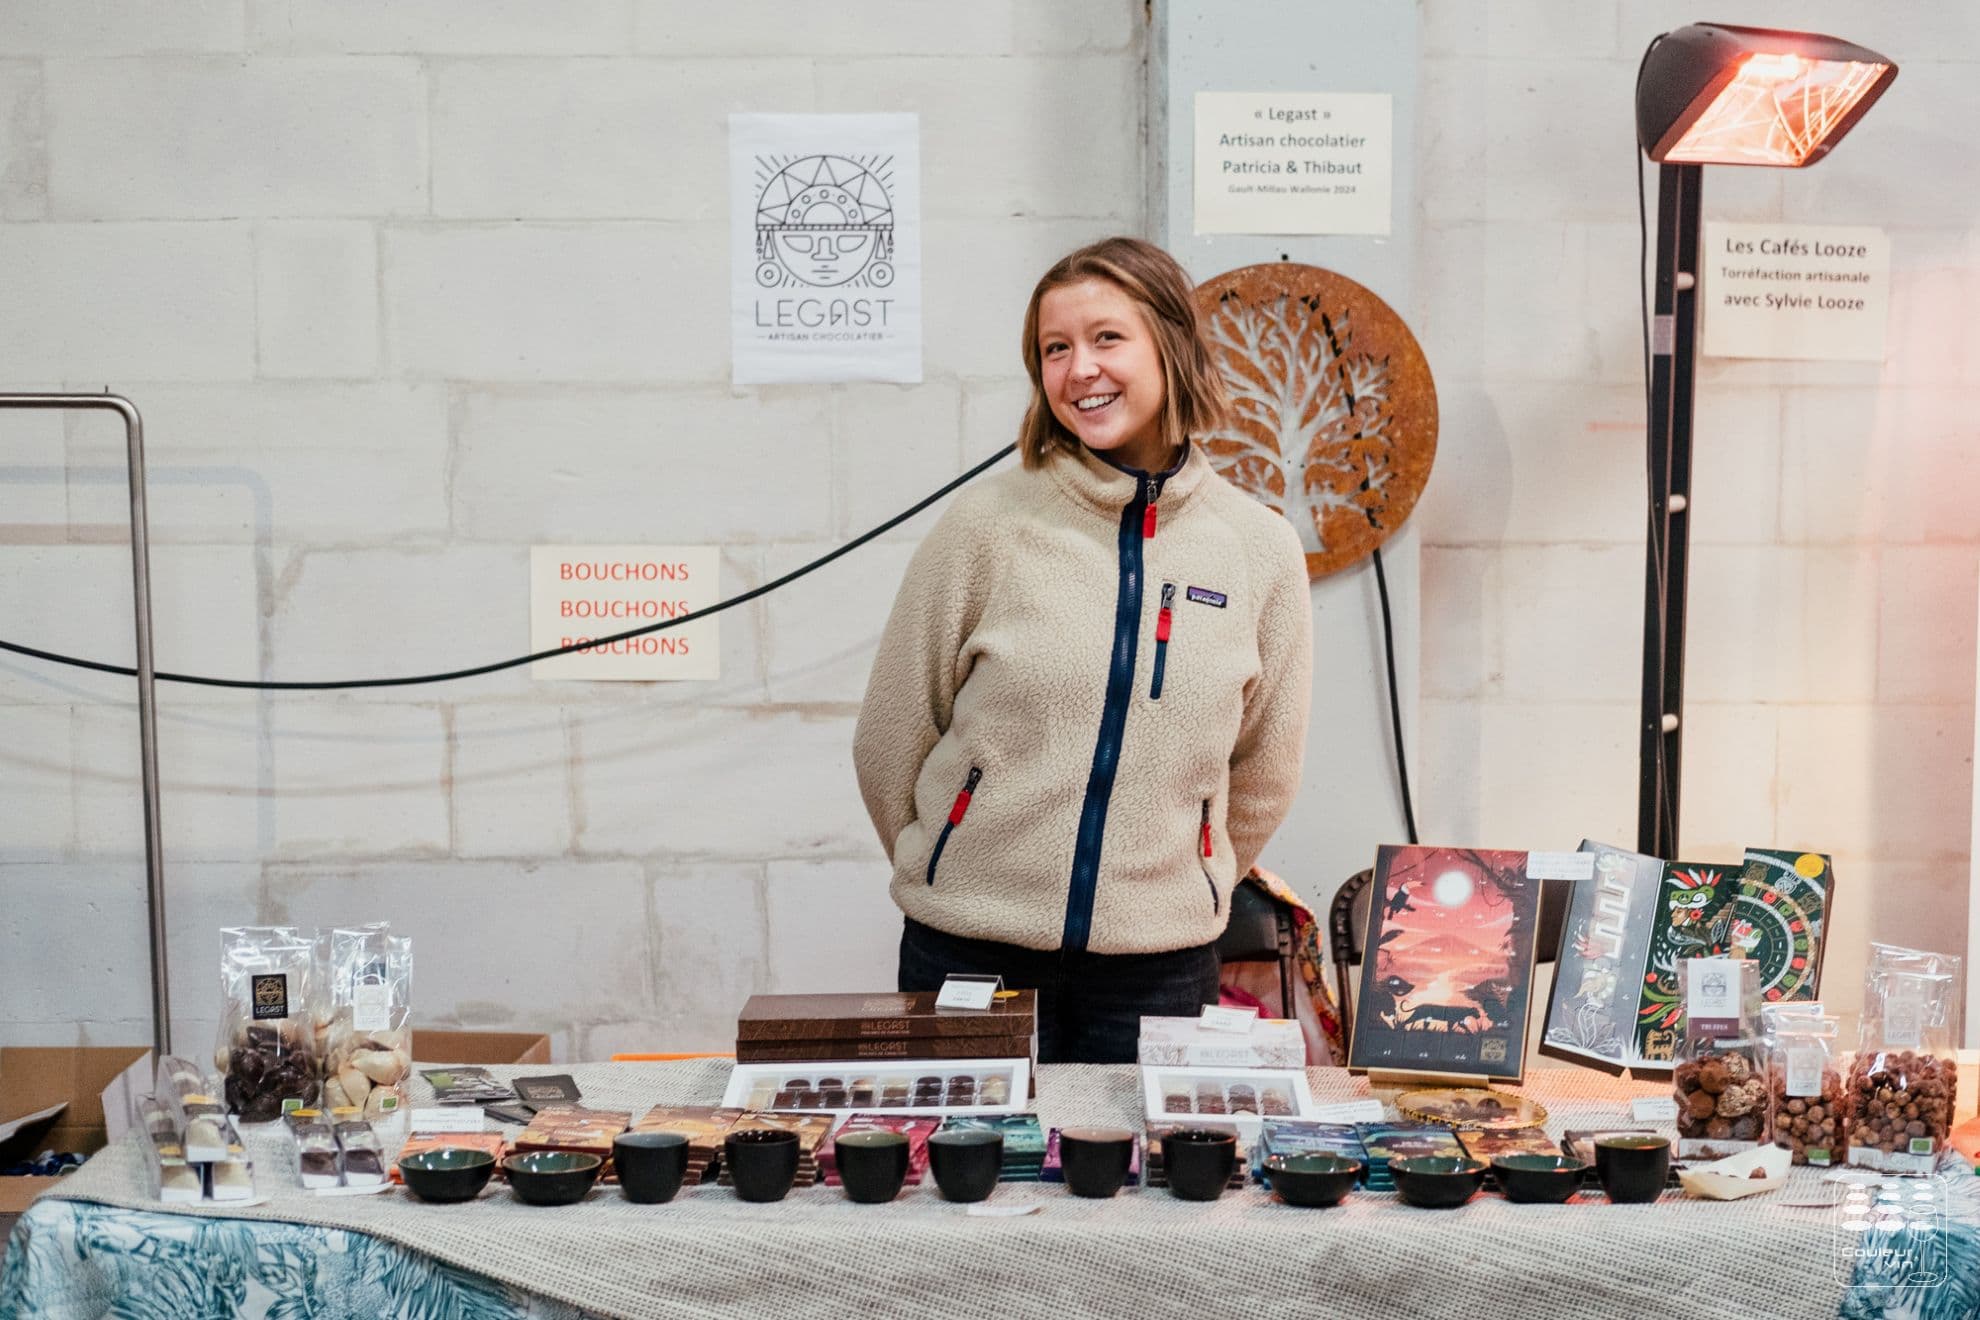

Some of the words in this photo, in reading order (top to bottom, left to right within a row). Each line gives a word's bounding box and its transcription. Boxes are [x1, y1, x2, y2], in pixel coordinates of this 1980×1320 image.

[1268, 107, 1317, 123] Legast
[1219, 133, 1275, 147] Artisan
[1280, 133, 1366, 148] chocolatier
[1222, 160, 1281, 174] Patricia
[1286, 160, 1298, 174] &
[1303, 160, 1363, 174] Thibaut
[1228, 184, 1254, 194] Gault
[1257, 184, 1287, 194] Millau
[1290, 184, 1331, 194] Wallonie
[1333, 185, 1357, 194] 2024
[1726, 238, 1754, 254] Les
[1760, 239, 1809, 256] Cafés
[1815, 241, 1867, 258] Looze
[1721, 267, 1801, 281] Torréfaction
[1805, 271, 1871, 283] artisanale
[1724, 295, 1760, 307] avec
[1765, 293, 1813, 310] Sylvie
[1818, 295, 1864, 310] Looze
[755, 298, 895, 327] LEGAST
[768, 332, 809, 342] ARTISAN
[812, 332, 884, 342] CHOCOLATIER
[560, 562, 690, 581] BOUCHONS
[560, 600, 690, 618] BOUCHONS
[561, 637, 690, 655] BOUCHONS
